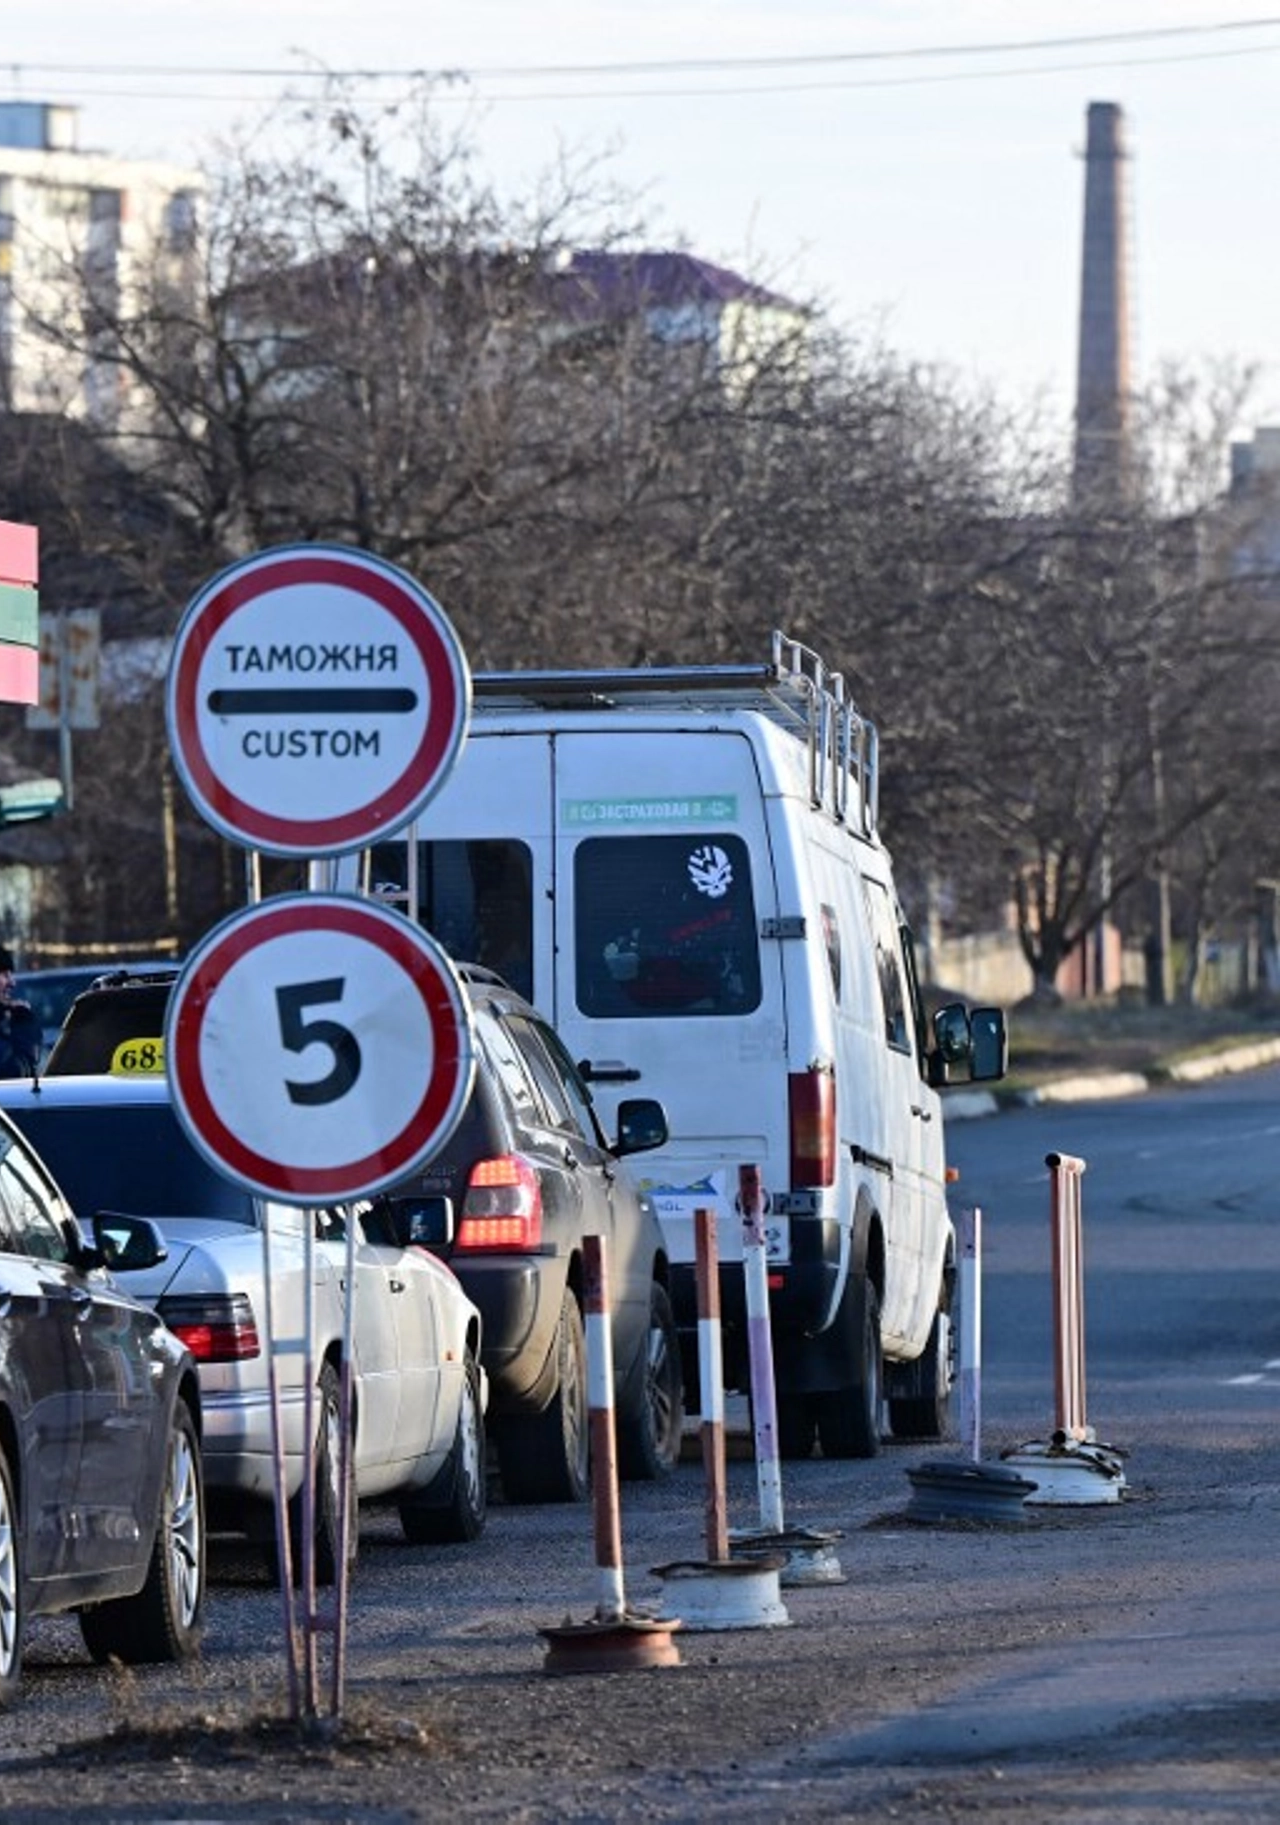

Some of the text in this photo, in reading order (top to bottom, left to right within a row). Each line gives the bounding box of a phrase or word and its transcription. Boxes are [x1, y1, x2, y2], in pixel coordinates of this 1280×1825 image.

[225, 645, 397, 672] ТАМОЖНЯ
[241, 729, 380, 758] CUSTOM
[275, 976, 362, 1106] 5
